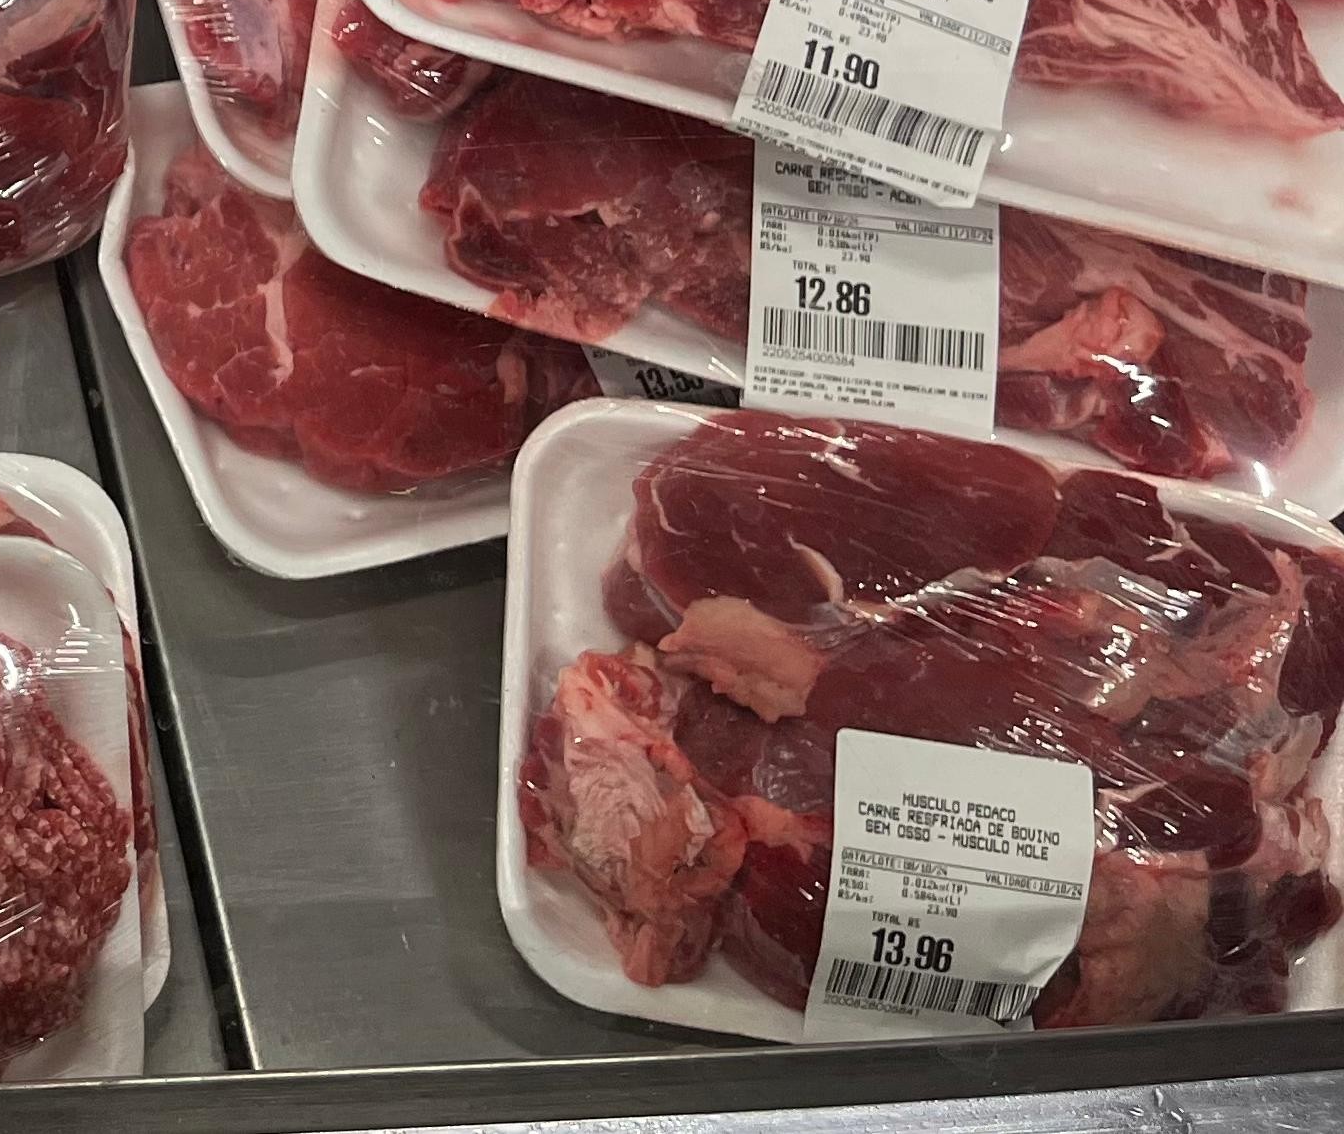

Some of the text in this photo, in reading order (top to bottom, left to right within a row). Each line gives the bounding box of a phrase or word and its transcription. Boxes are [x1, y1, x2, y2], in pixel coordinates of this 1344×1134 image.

[798, 37, 884, 90] 11,90
[776, 160, 812, 177] CARNE
[808, 180, 831, 195] SEM
[795, 276, 871, 316] 12,86
[858, 802, 1059, 846] CARNE RESFRIADA DE BOVINO
[903, 793, 1016, 822] MUSCULO PEDACO
[865, 819, 890, 835] SEM
[897, 824, 930, 842] OSSO
[952, 833, 1009, 854] MUSCULO
[1016, 844, 1048, 860] MOLE
[872, 927, 955, 973] 13,96
